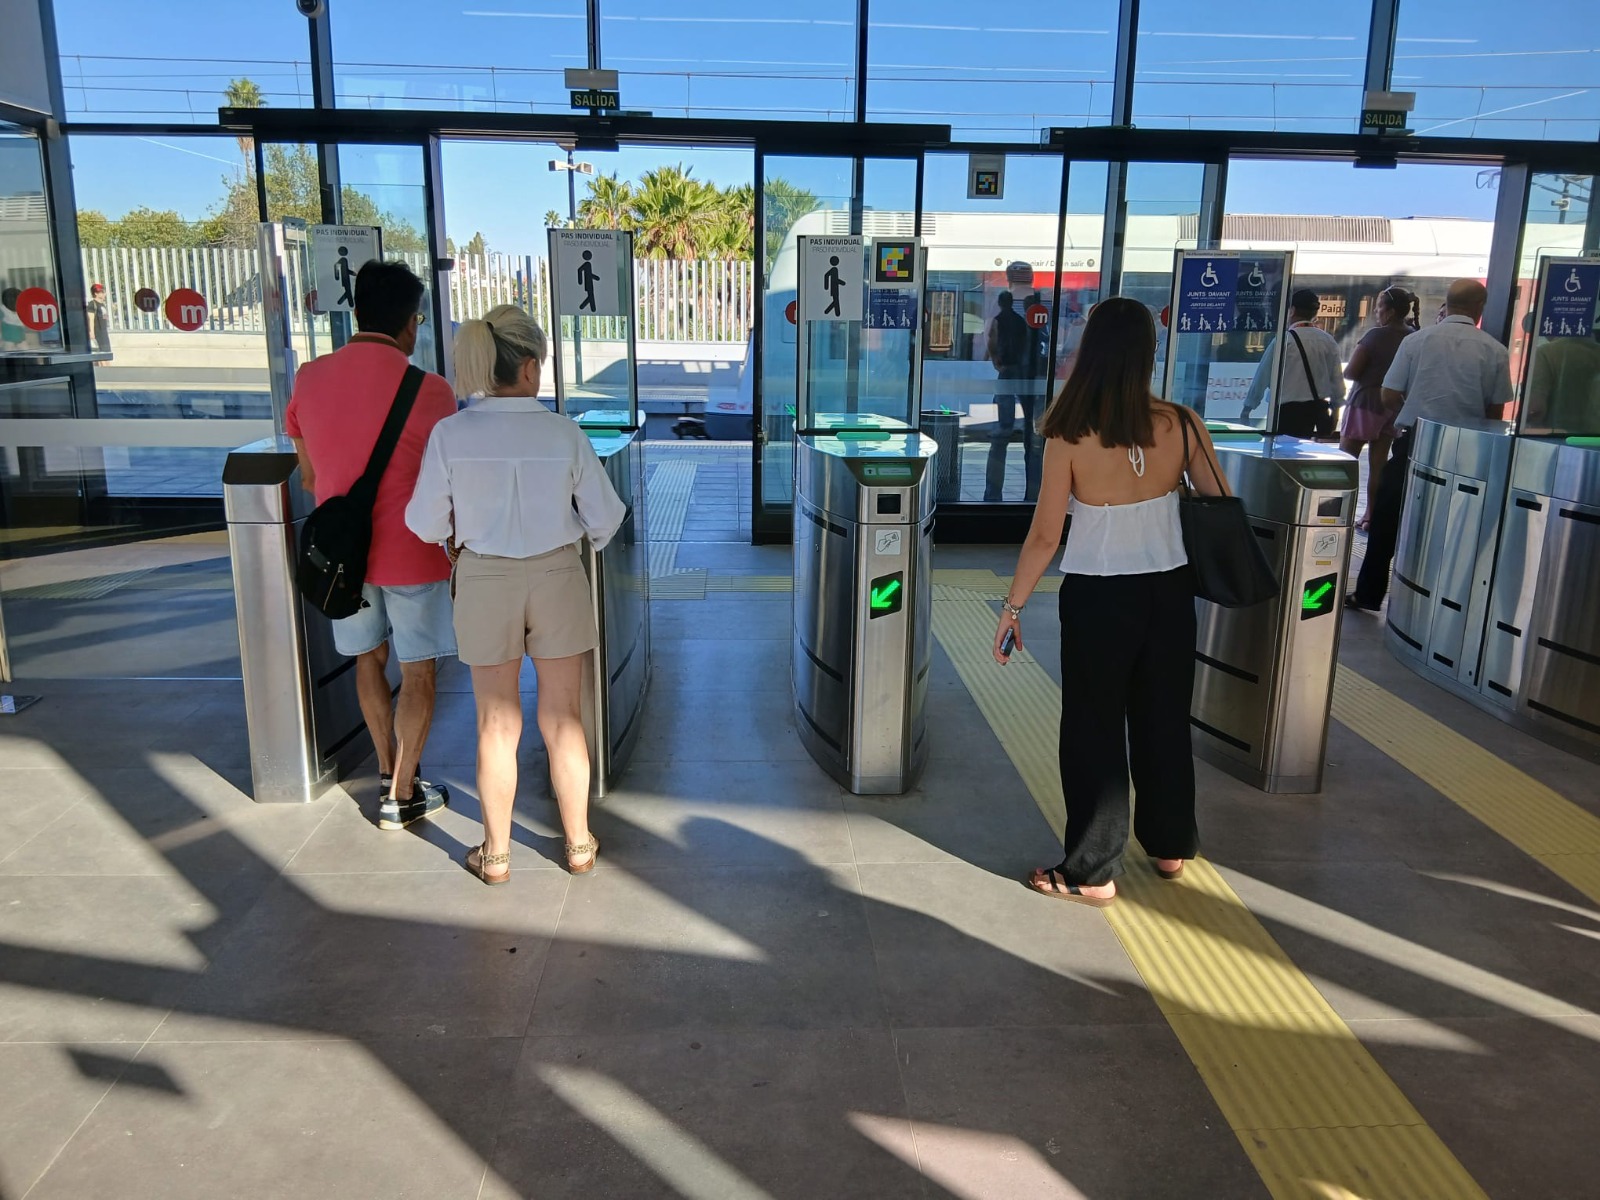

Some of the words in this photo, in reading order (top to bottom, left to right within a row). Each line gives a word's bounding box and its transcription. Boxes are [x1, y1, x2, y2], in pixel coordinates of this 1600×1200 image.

[574, 94, 616, 107] SALIDA
[1364, 113, 1403, 126] SALIDA
[330, 229, 369, 237] INDIVIDUAL
[560, 232, 574, 240] PAS
[31, 303, 58, 323] m
[180, 304, 206, 324] m
[1033, 312, 1048, 324] m
